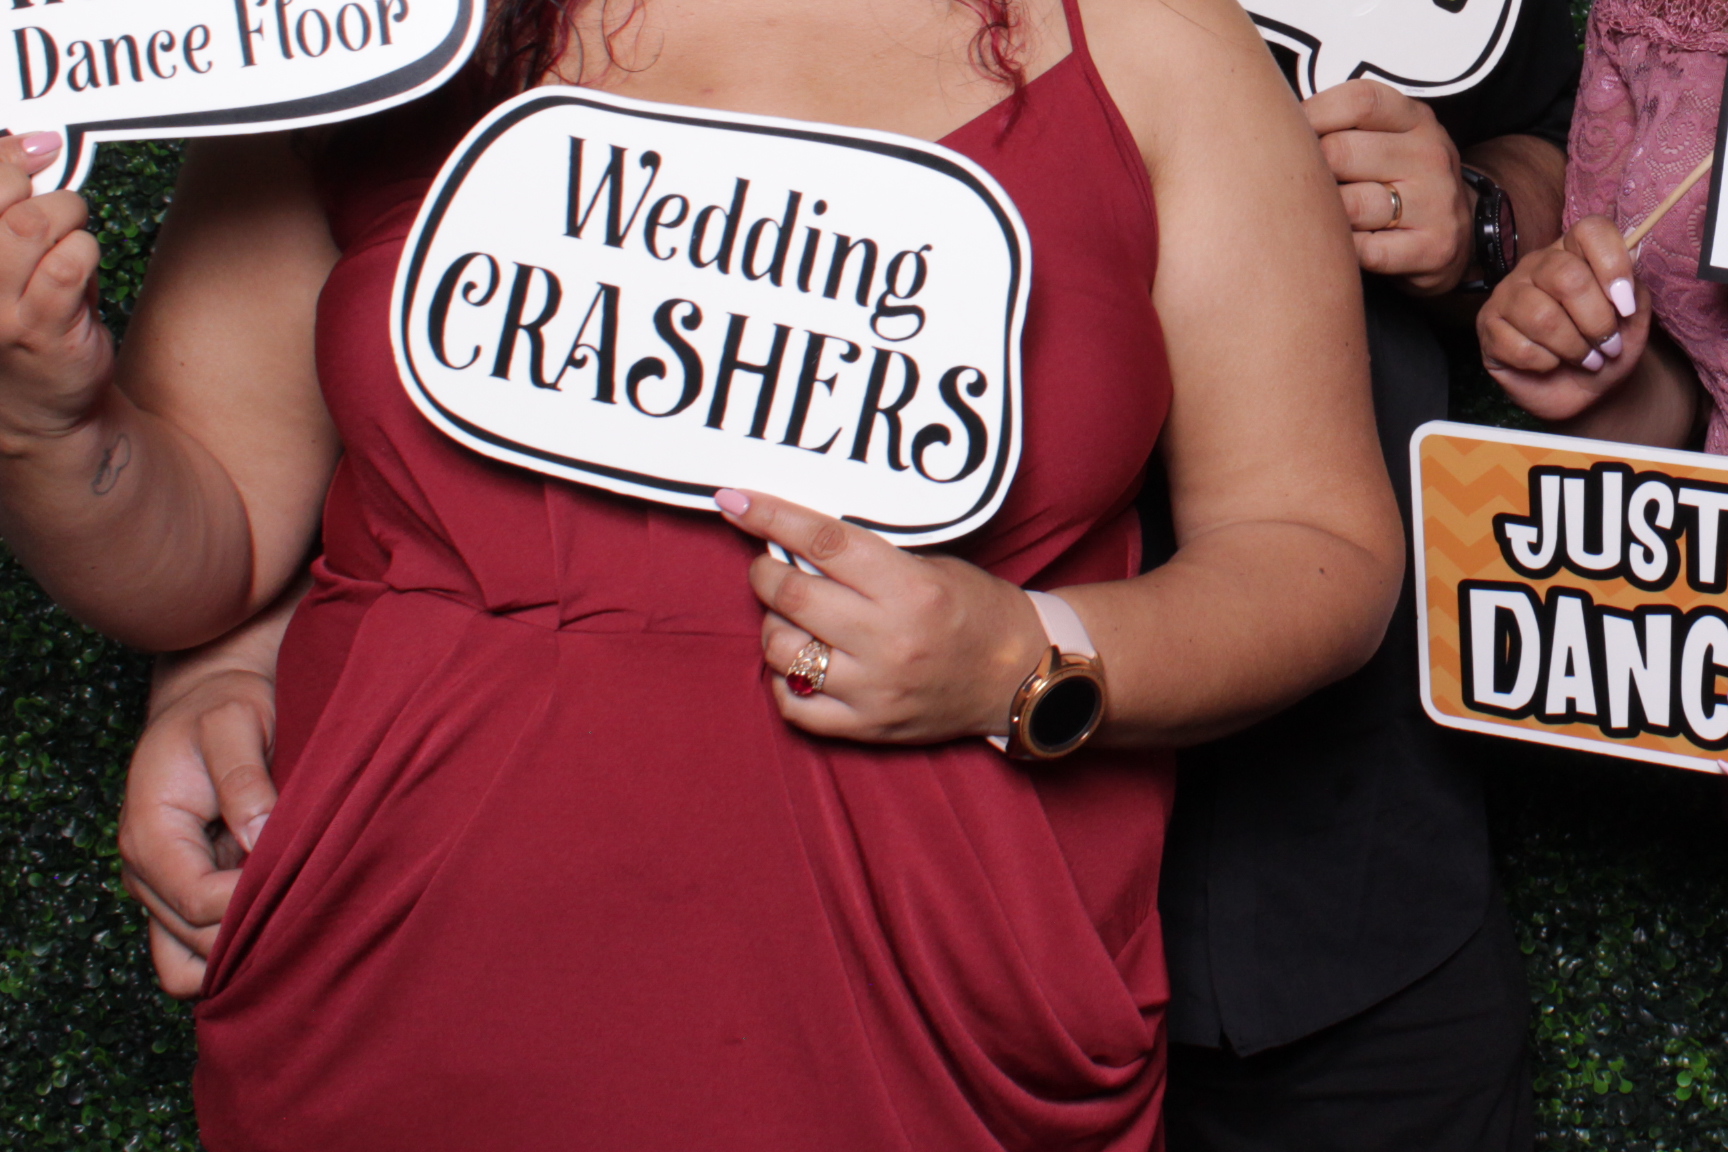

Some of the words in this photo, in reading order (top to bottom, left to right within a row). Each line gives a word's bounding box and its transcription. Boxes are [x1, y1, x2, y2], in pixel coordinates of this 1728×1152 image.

[13, 26, 213, 101] Dance
[563, 135, 933, 342] Wedding
[427, 251, 989, 484] CRASHERS
